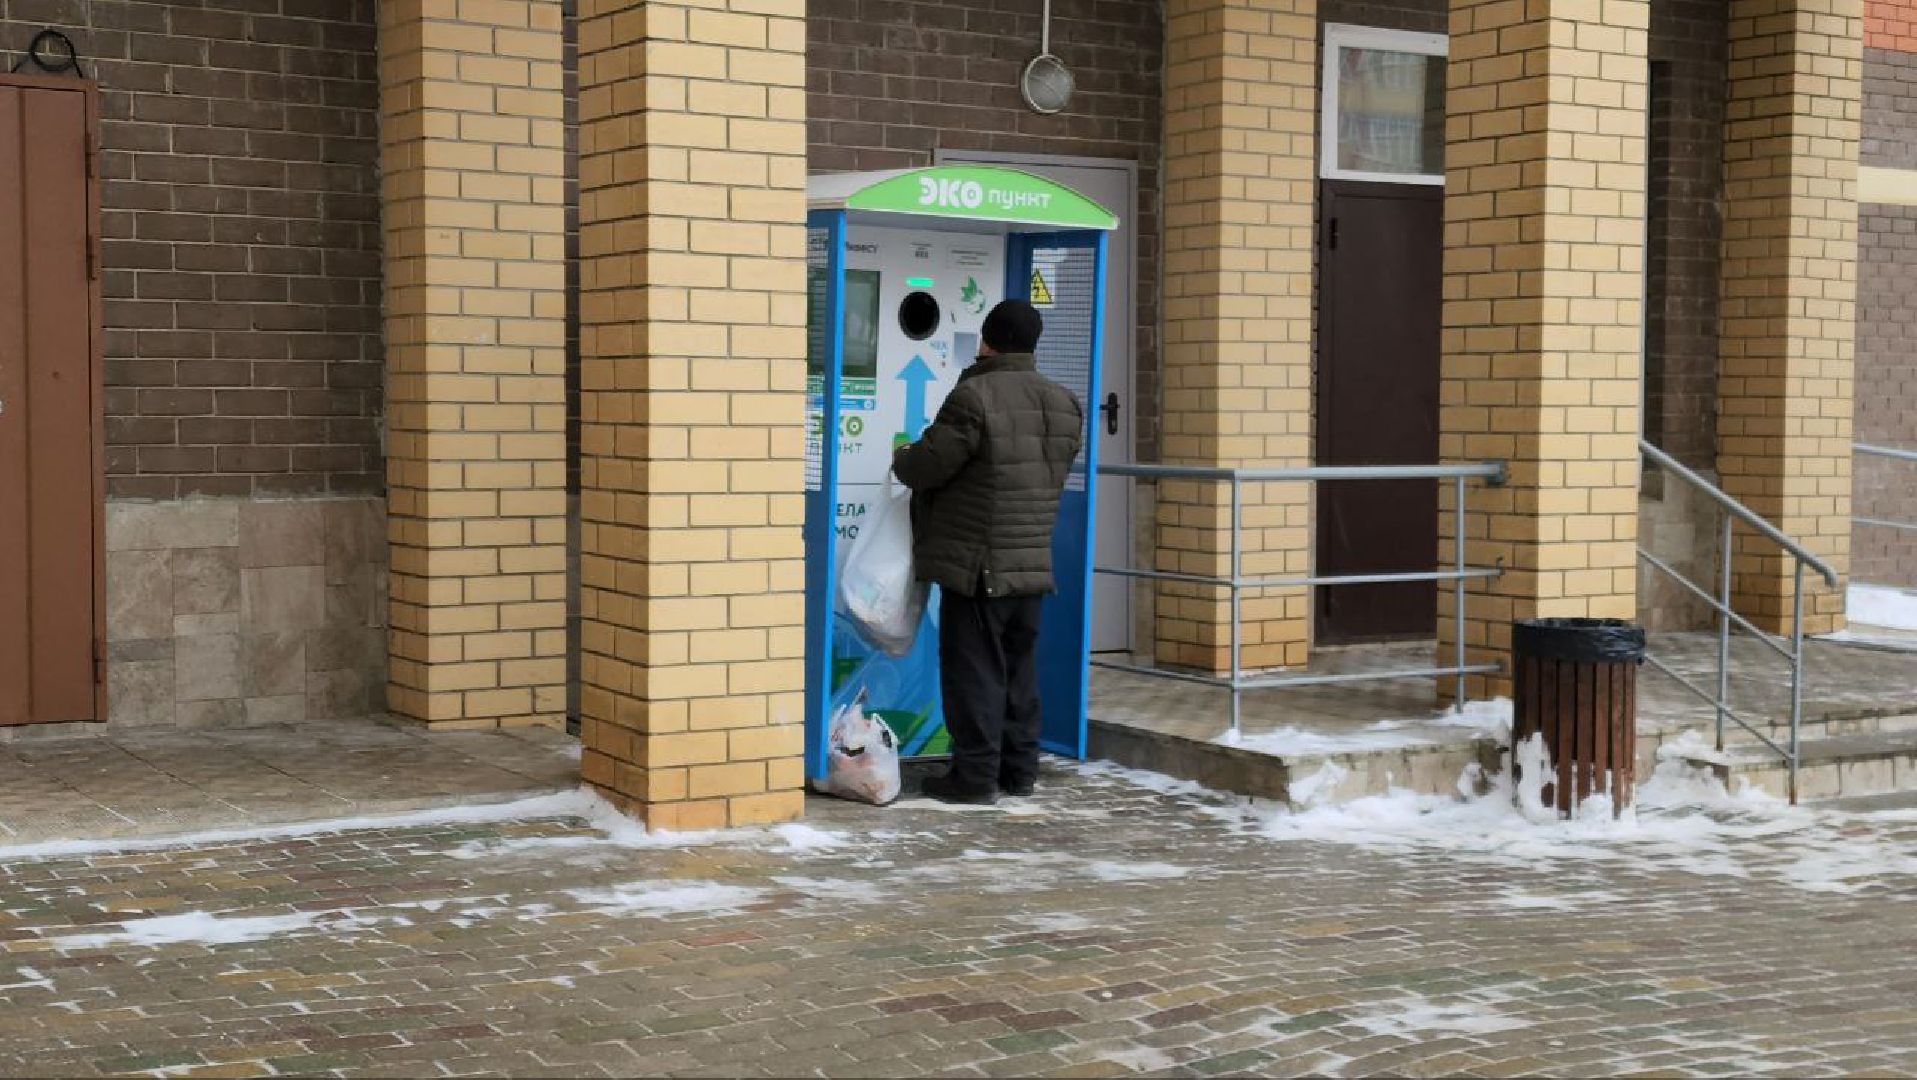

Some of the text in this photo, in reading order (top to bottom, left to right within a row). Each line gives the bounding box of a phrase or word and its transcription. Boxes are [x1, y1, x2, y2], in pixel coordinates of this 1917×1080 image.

[918, 175, 1052, 210] ЭКО пункт
[836, 503, 866, 518] ЕЛА
